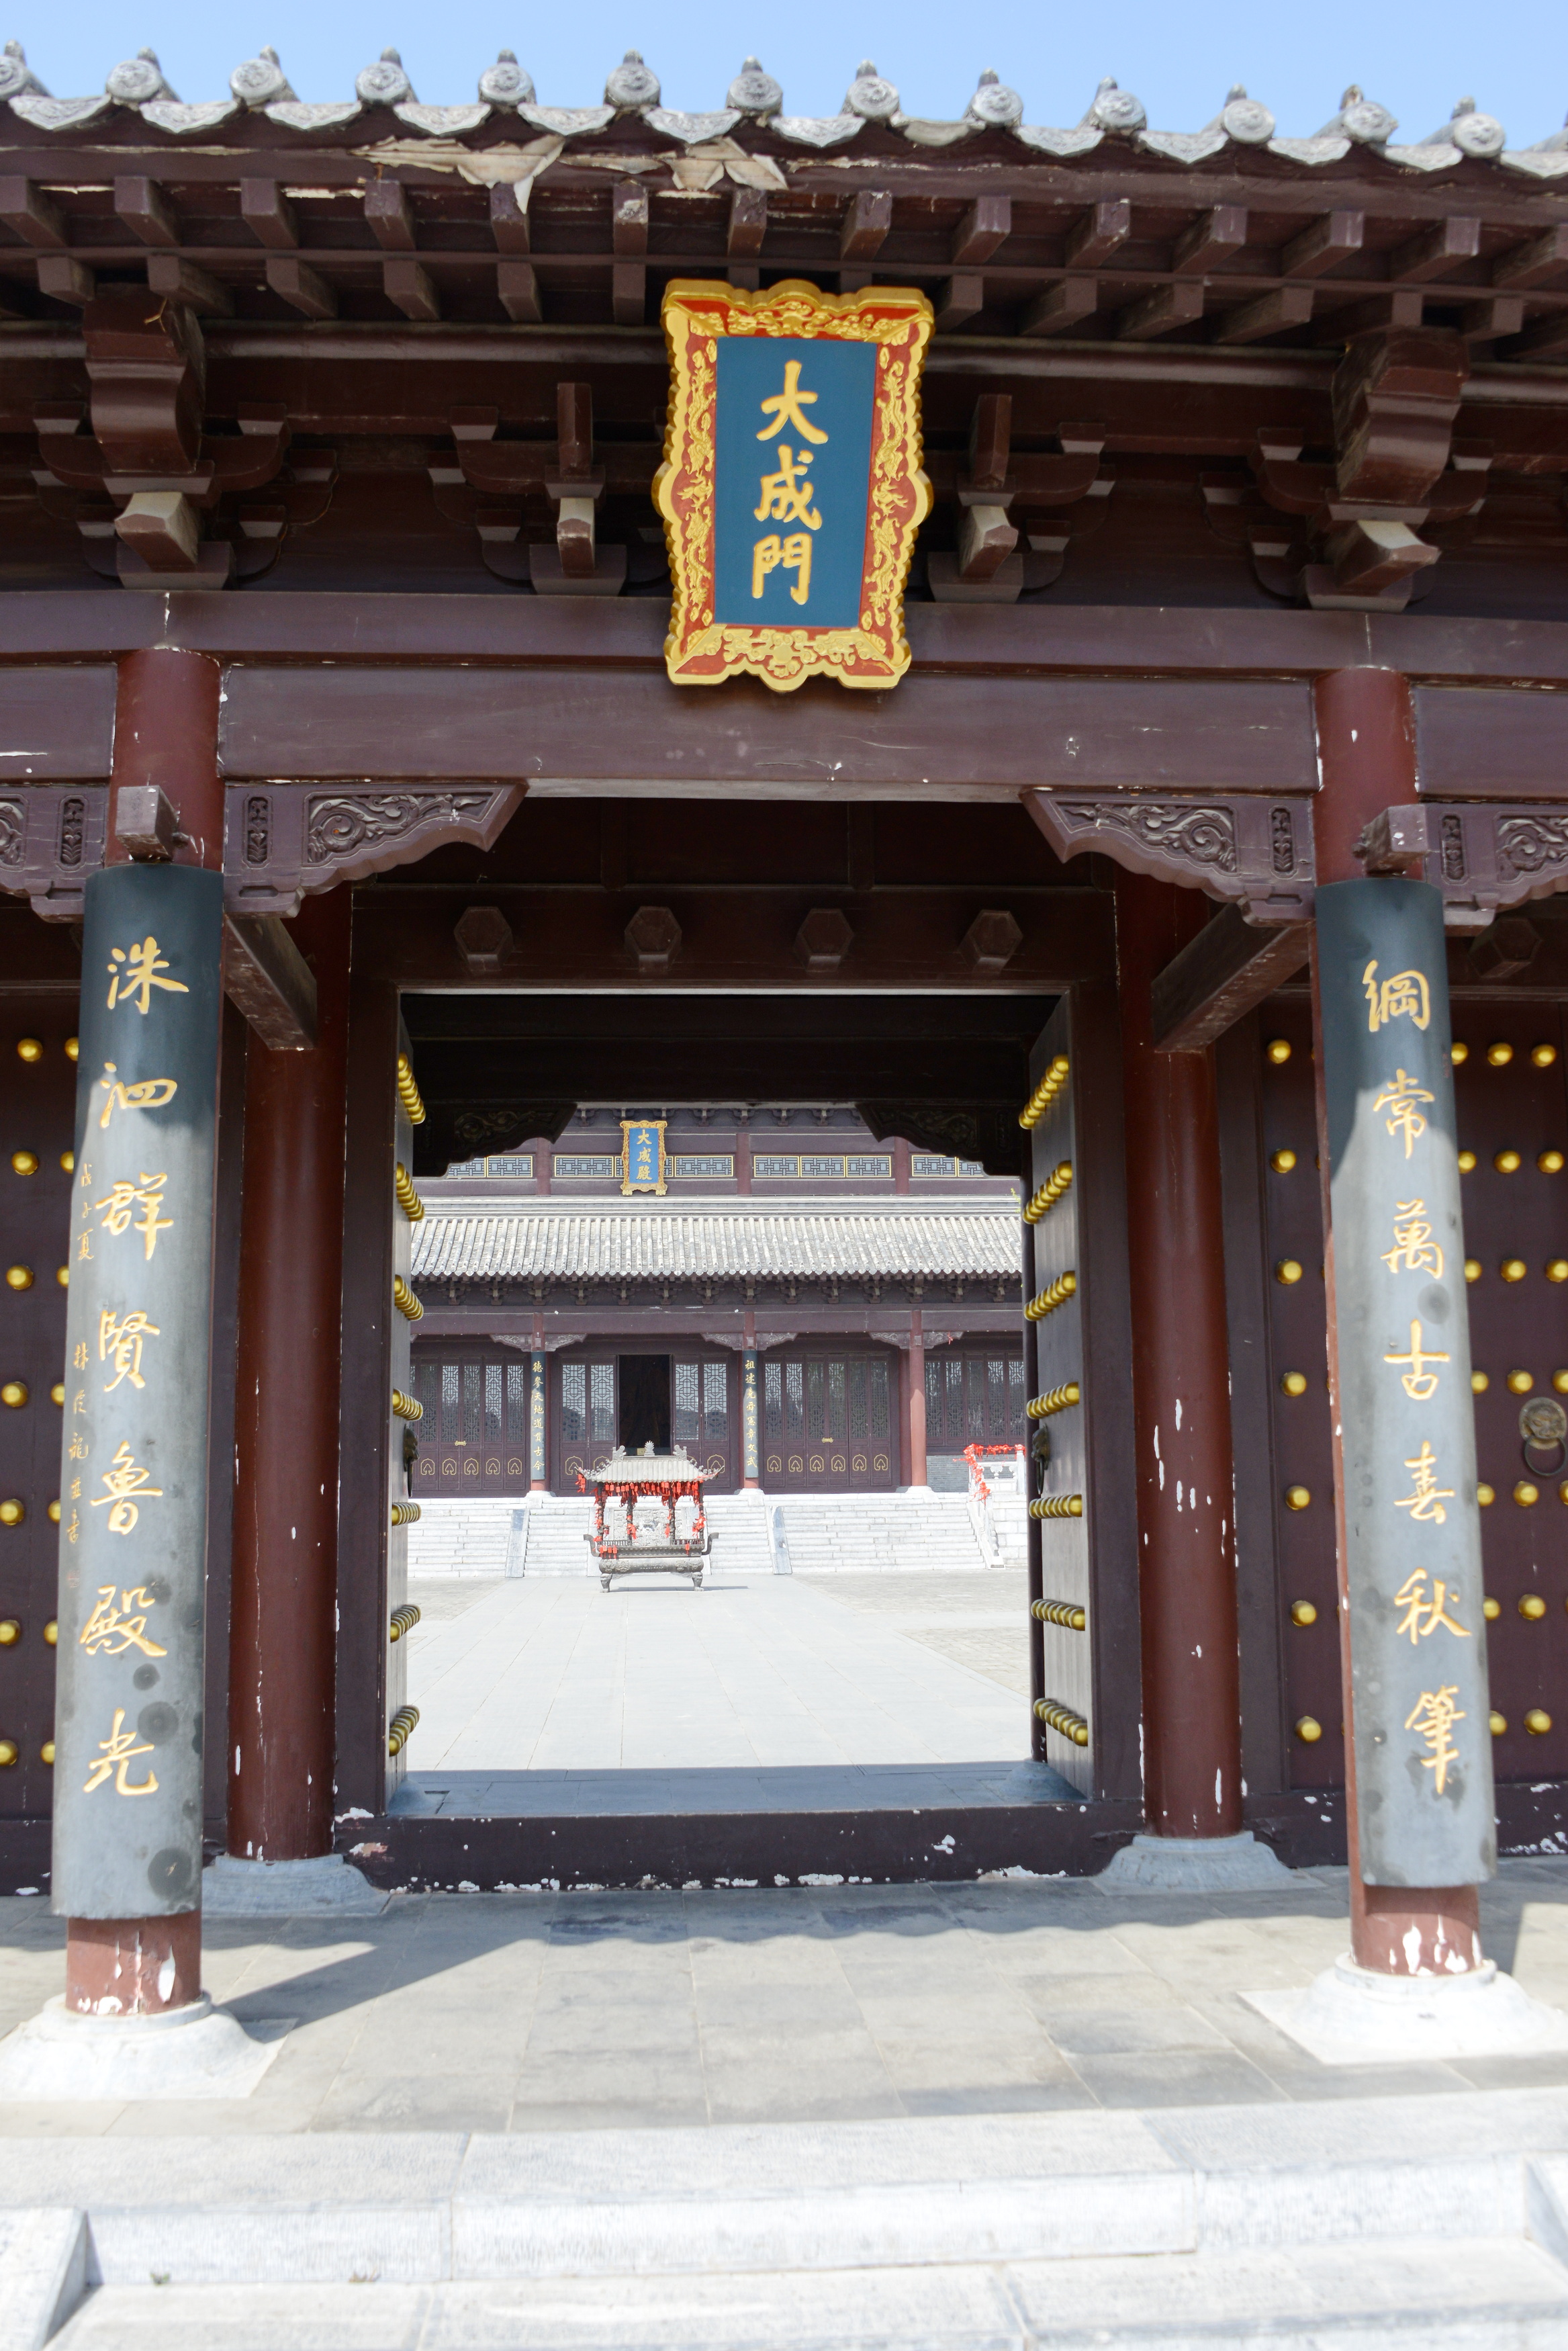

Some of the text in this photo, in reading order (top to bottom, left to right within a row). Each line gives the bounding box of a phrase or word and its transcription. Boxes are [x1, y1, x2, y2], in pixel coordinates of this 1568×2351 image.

[752, 359, 829, 605] 大成門
[636, 1128, 653, 1181] 大成殿
